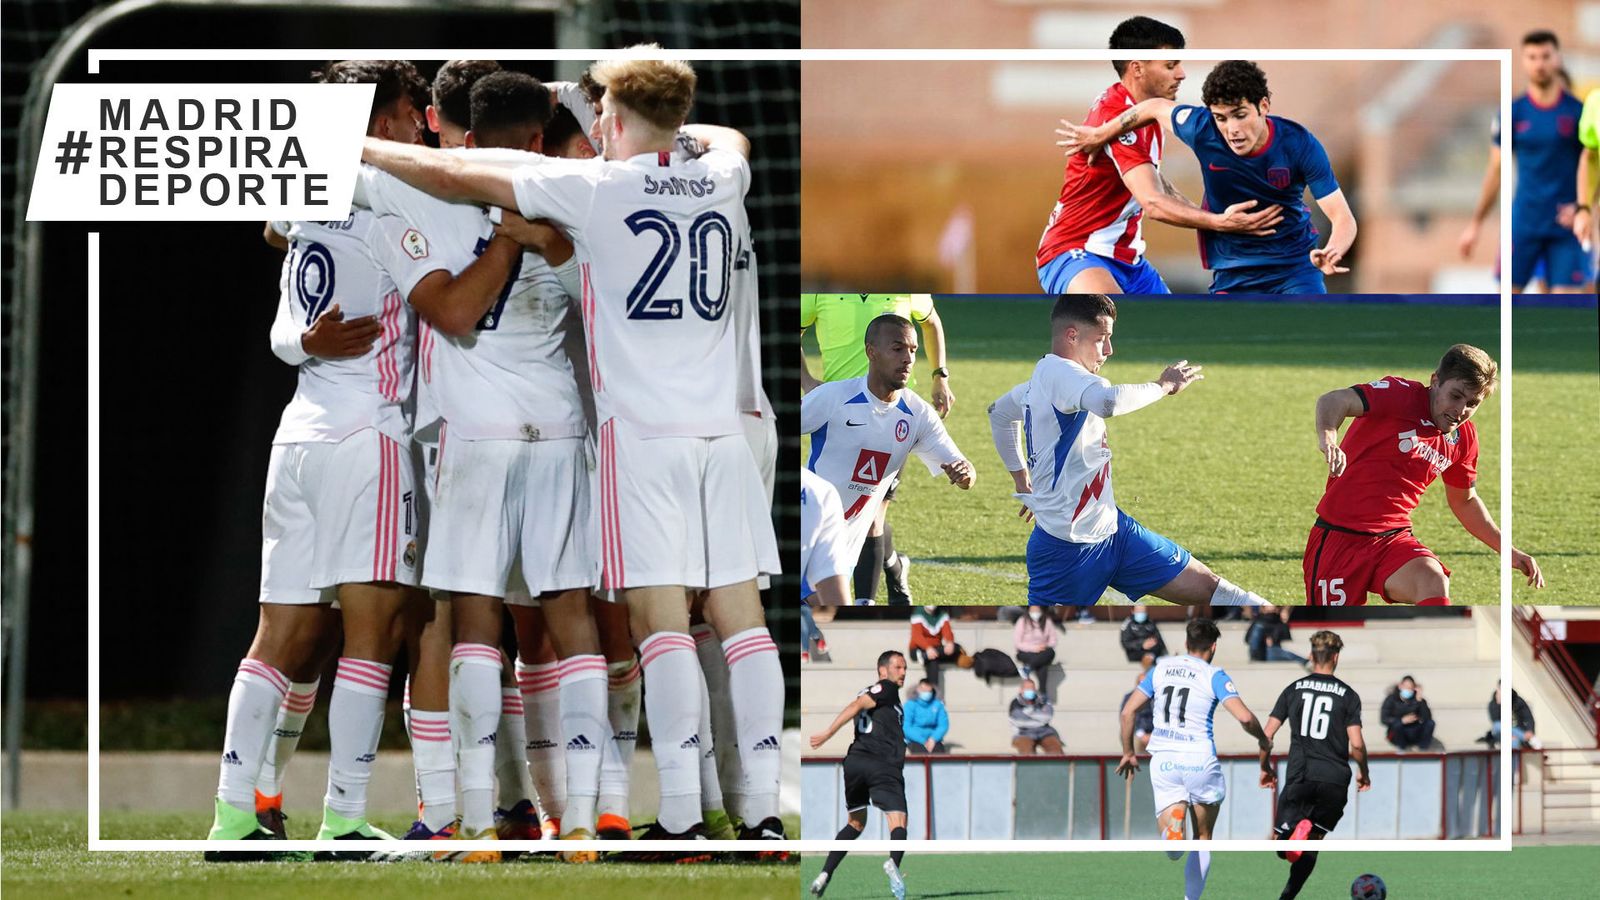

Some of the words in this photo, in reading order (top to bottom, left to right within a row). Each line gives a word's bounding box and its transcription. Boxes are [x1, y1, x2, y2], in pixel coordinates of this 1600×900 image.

[643, 174, 716, 198] SANTOS
[624, 208, 733, 322] 20
[1317, 577, 1347, 606] 15
[1165, 667, 1188, 678] MANEL
[1162, 685, 1191, 729] 11
[1300, 692, 1334, 740] 16
